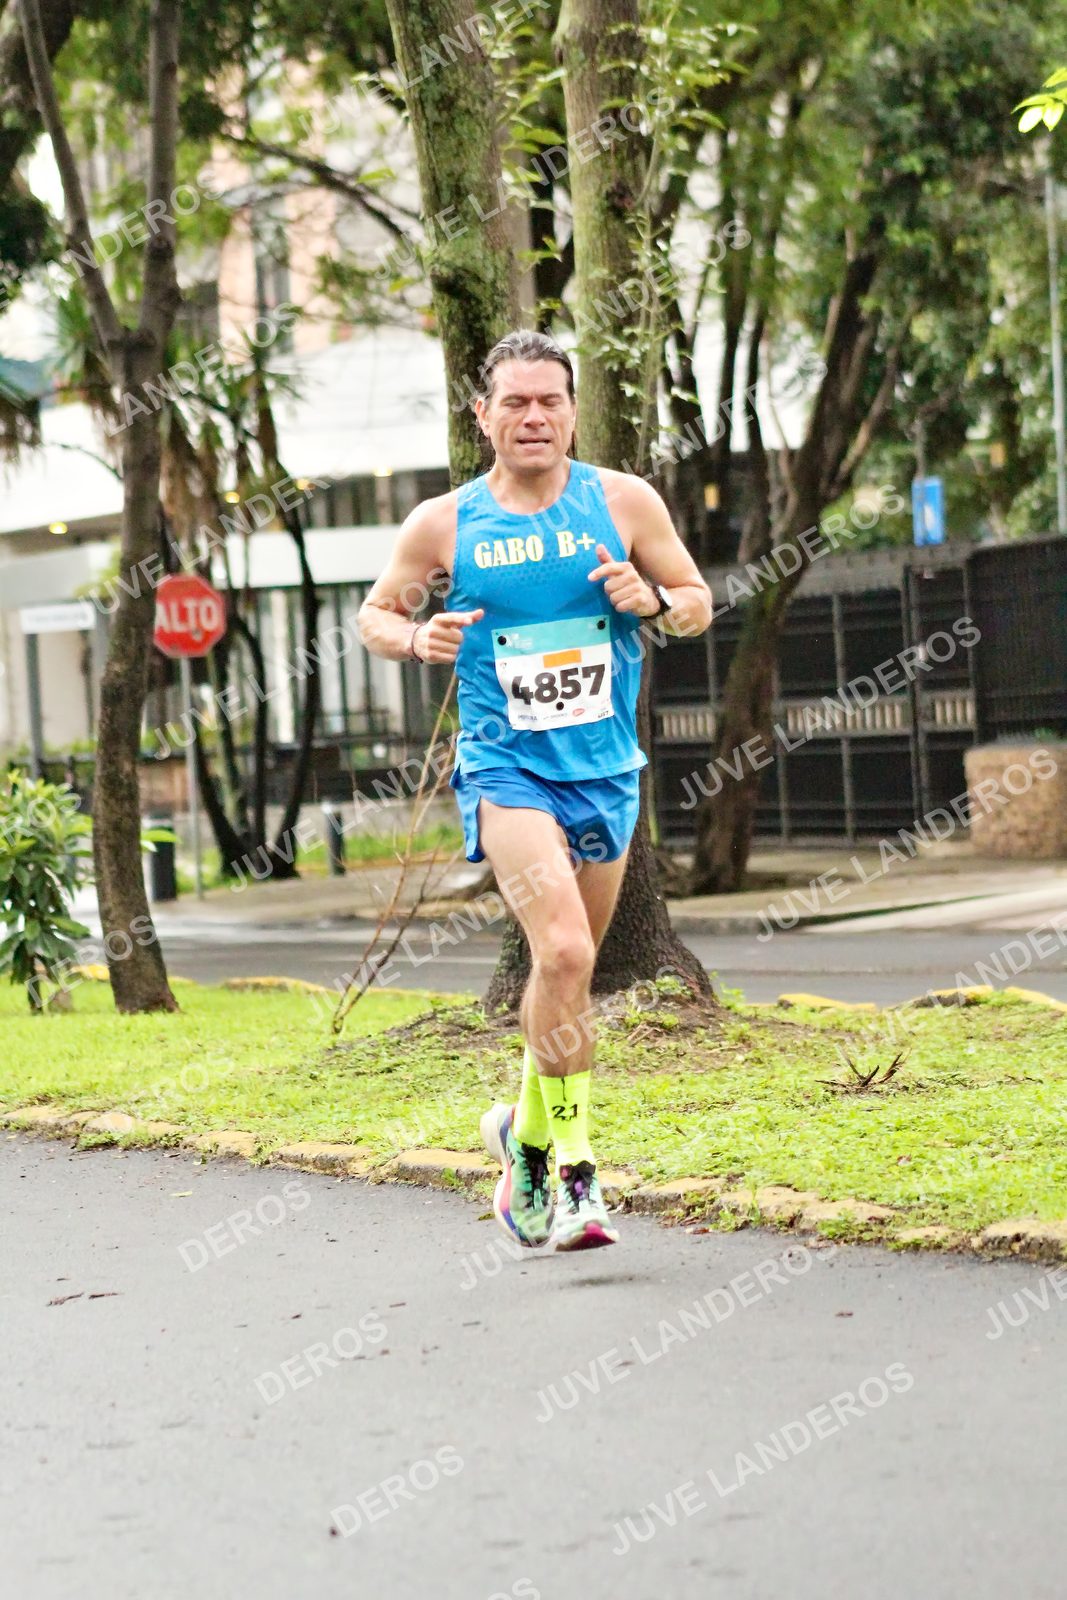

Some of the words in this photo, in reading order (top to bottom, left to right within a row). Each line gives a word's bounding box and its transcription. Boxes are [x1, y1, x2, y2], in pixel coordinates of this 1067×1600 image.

[474, 534, 544, 569] GABO
[556, 531, 596, 558] B+
[154, 597, 219, 634] ALTO
[512, 664, 605, 705] 4857
